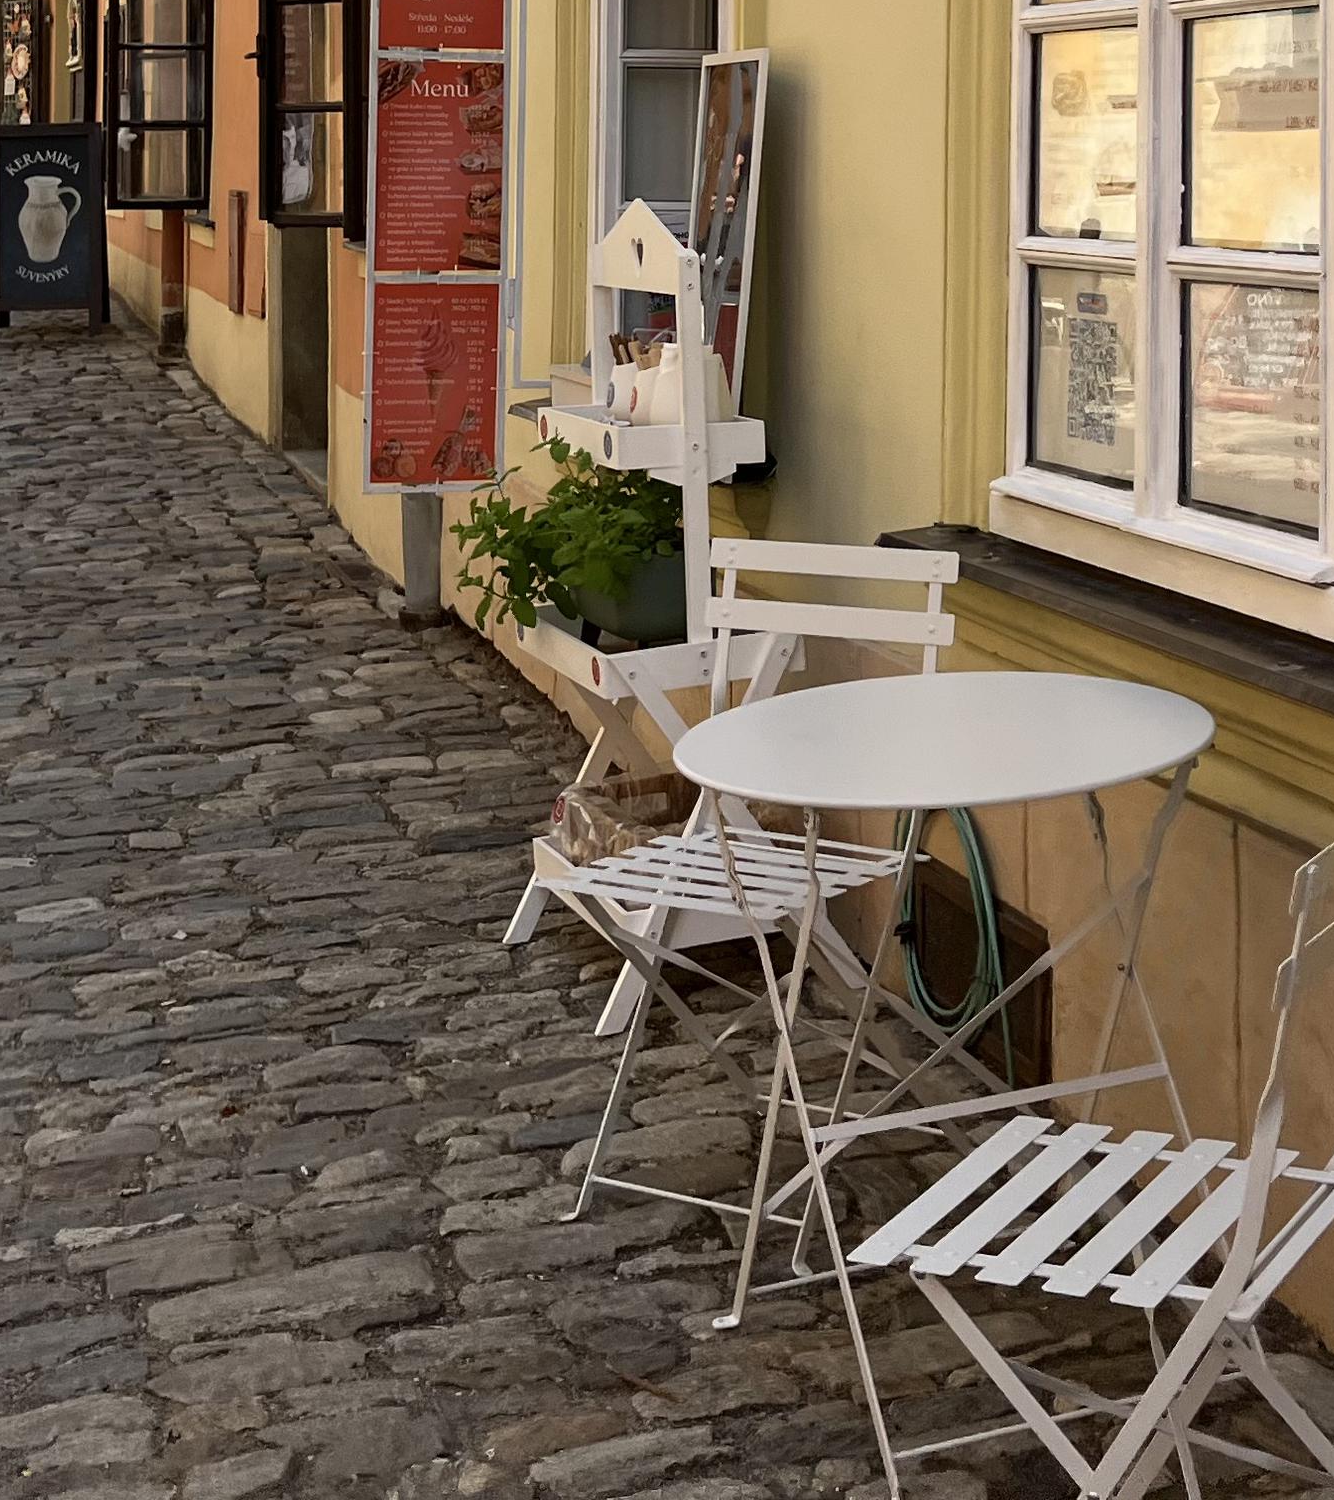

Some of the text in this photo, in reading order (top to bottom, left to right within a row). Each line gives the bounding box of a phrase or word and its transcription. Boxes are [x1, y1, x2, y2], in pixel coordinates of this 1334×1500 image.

[411, 79, 469, 98] Menu
[5, 150, 81, 177] KERAMIKA
[16, 265, 70, 283] SUVENÝRY
